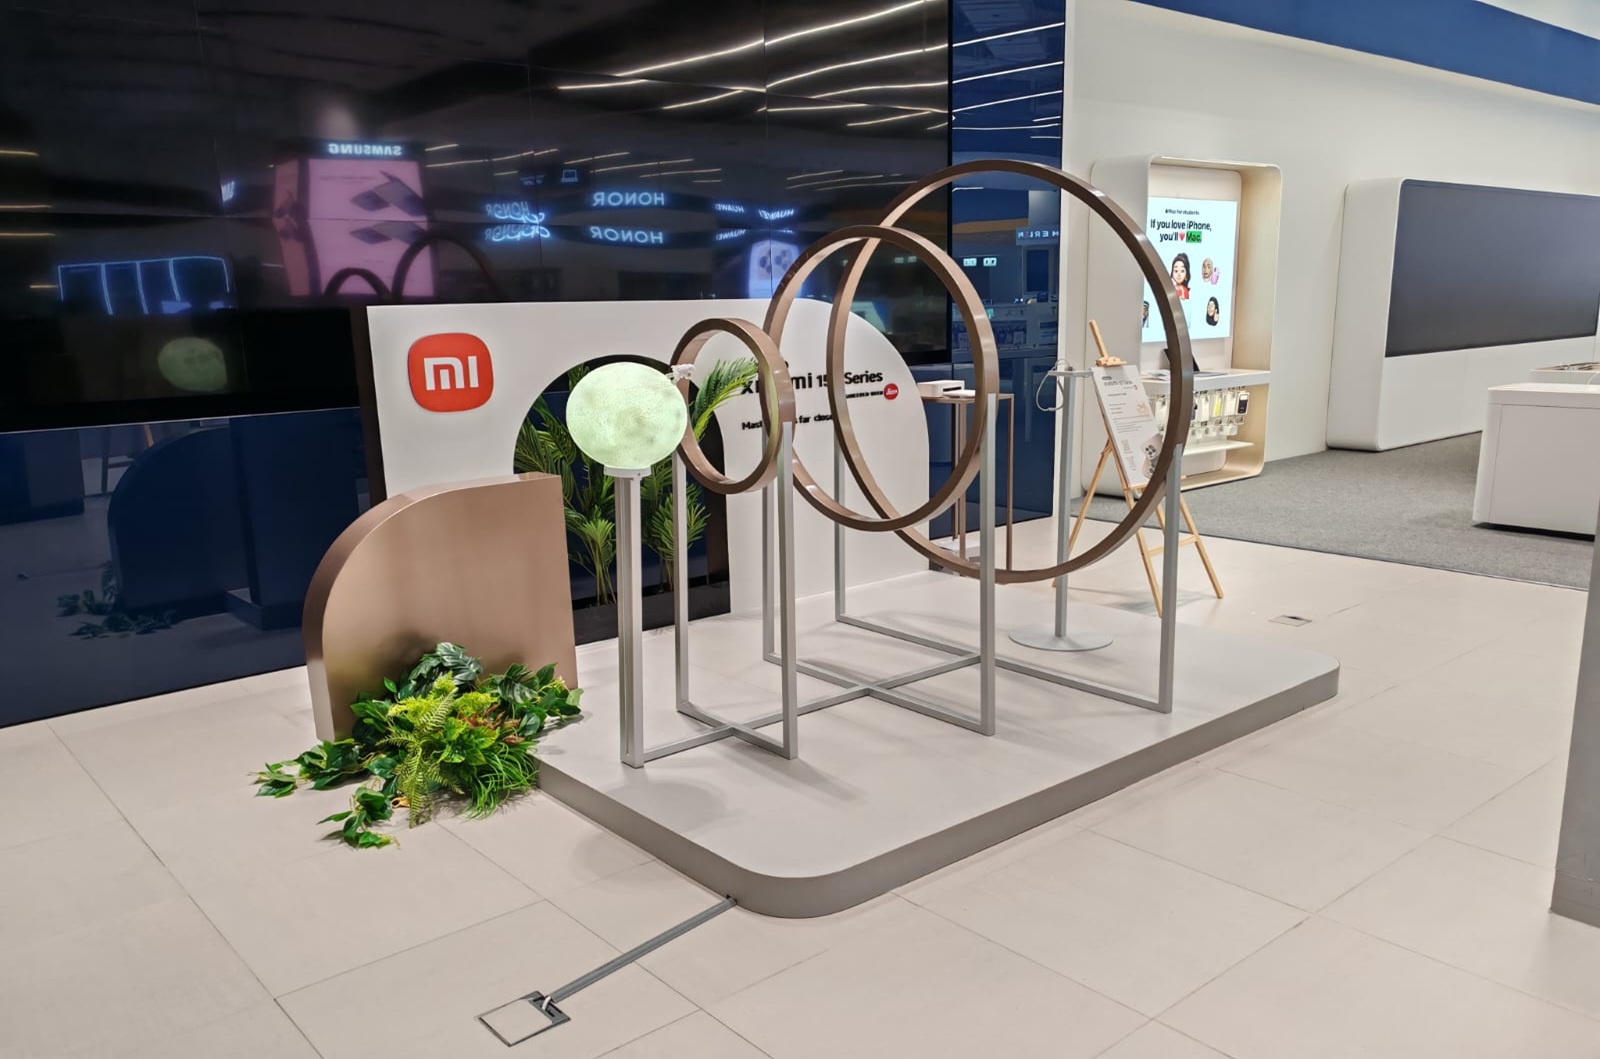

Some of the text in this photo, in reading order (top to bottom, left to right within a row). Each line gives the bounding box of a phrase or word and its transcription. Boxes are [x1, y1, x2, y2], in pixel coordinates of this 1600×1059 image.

[1151, 219, 1212, 232] If you love iPhone,
[844, 370, 883, 385] Series
[813, 413, 833, 423] close
